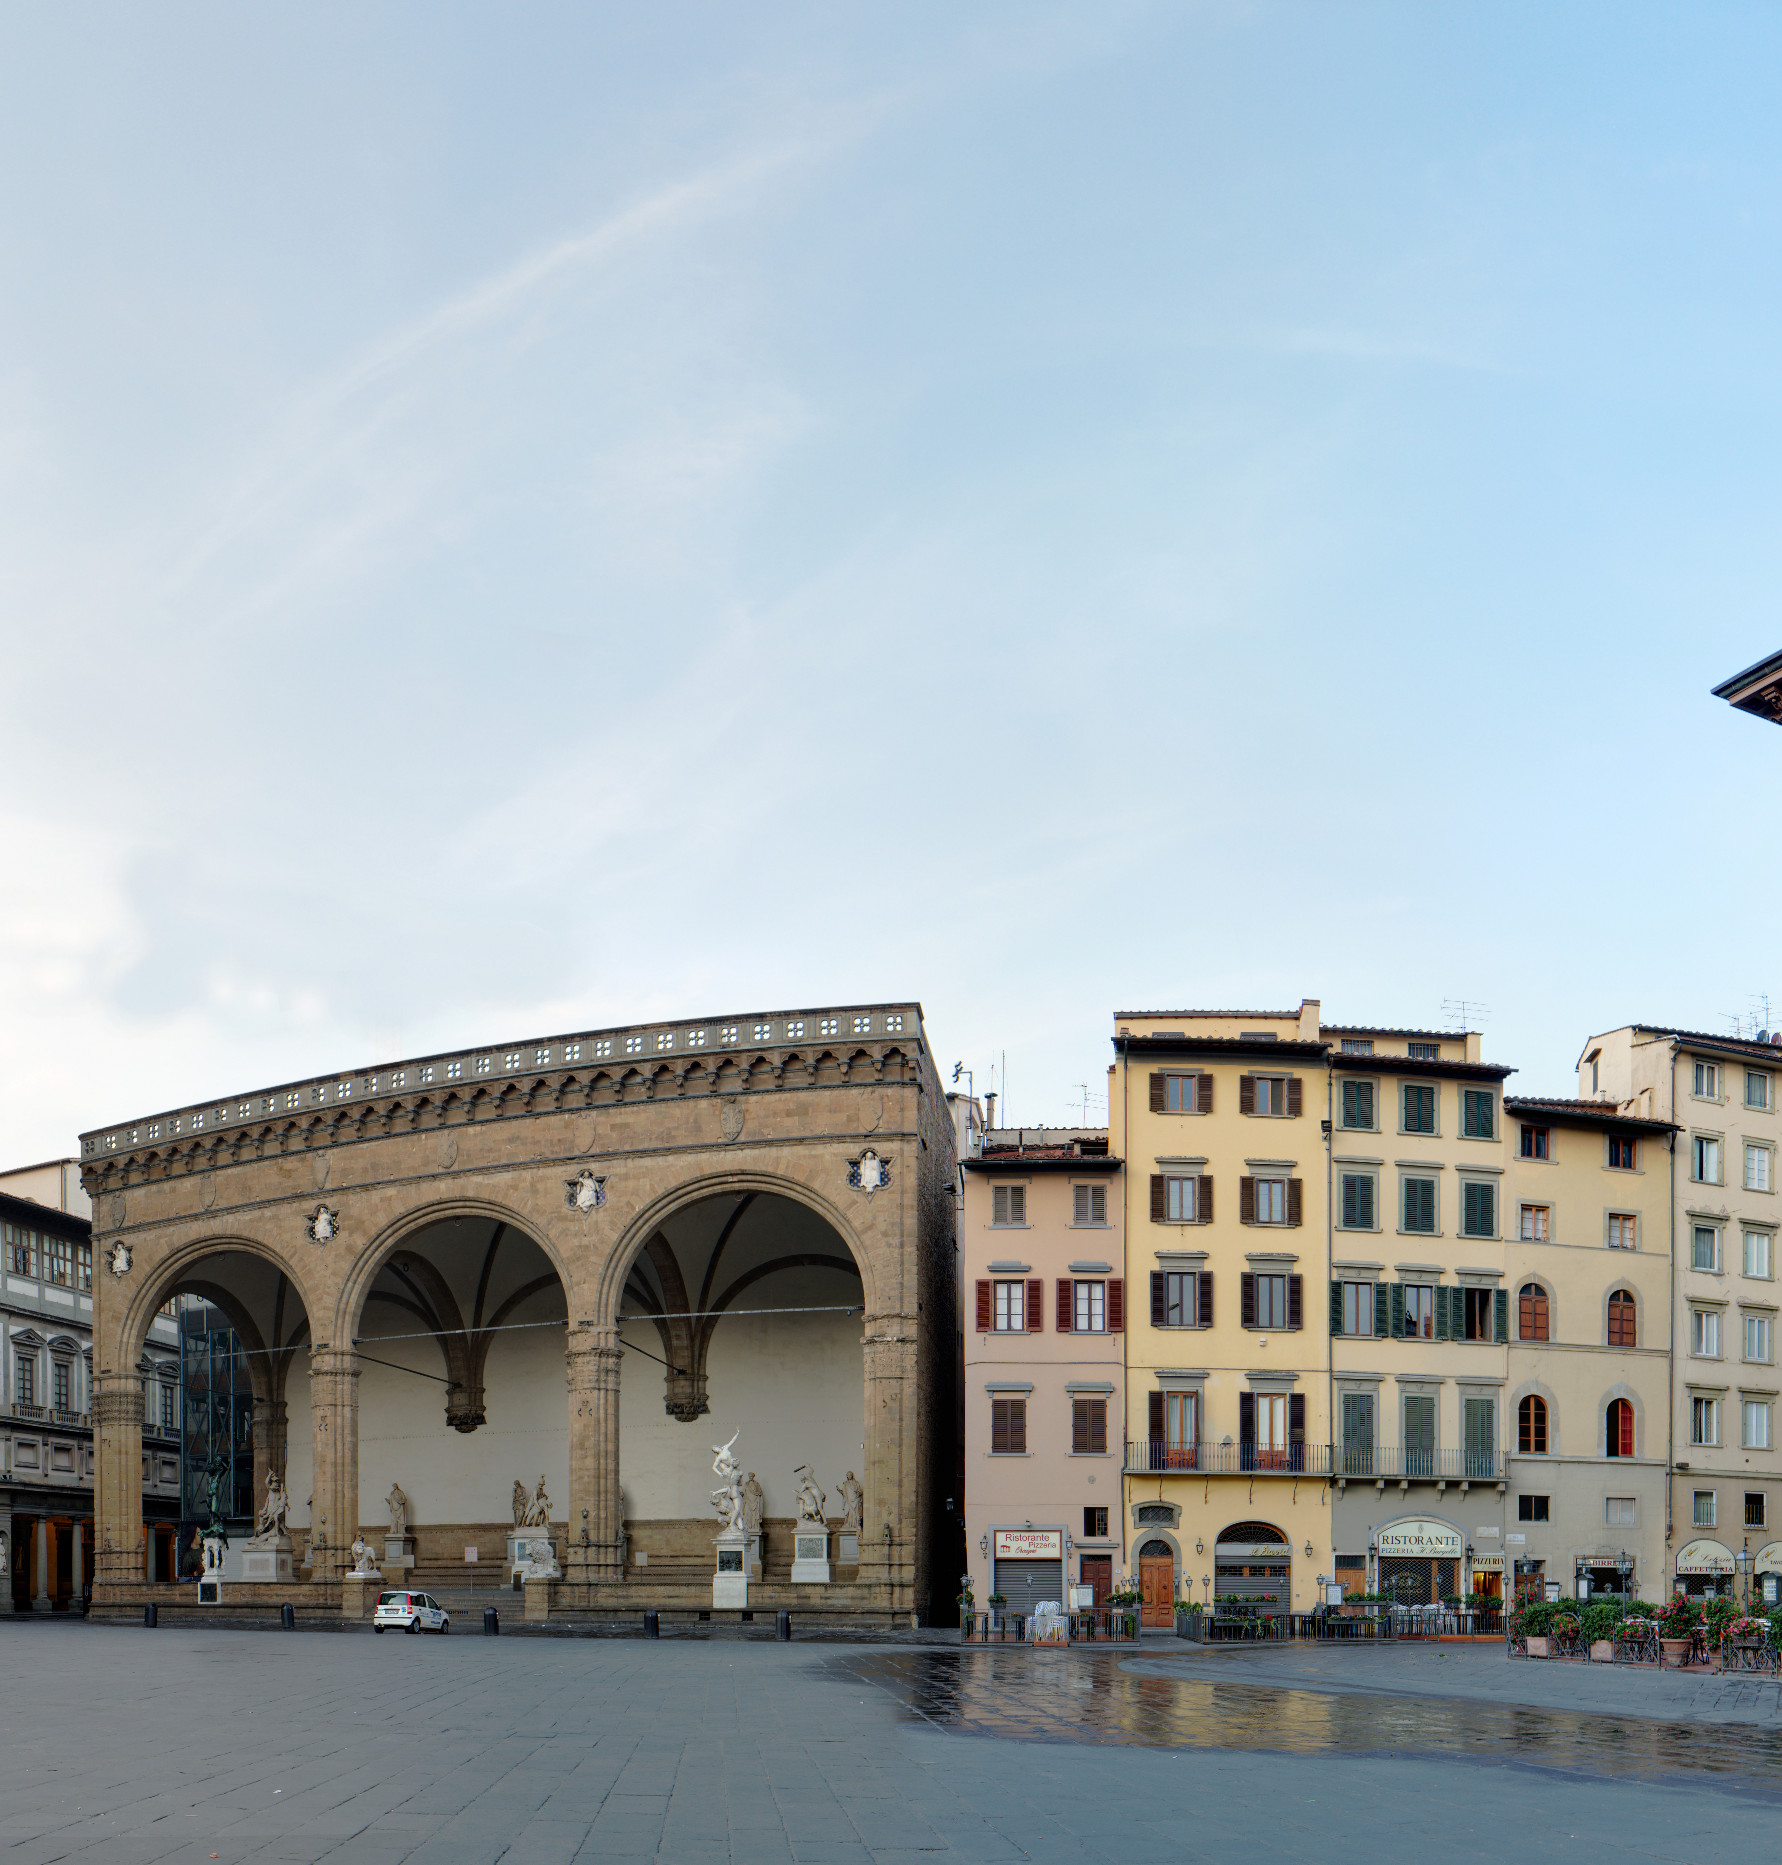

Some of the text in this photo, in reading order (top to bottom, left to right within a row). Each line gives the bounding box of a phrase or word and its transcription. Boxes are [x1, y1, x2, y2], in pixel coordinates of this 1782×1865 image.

[1005, 1533, 1049, 1541] Ristorante
[1381, 1535, 1459, 1546] RISTORANTE
[1473, 1557, 1505, 1565] PIZZERIA
